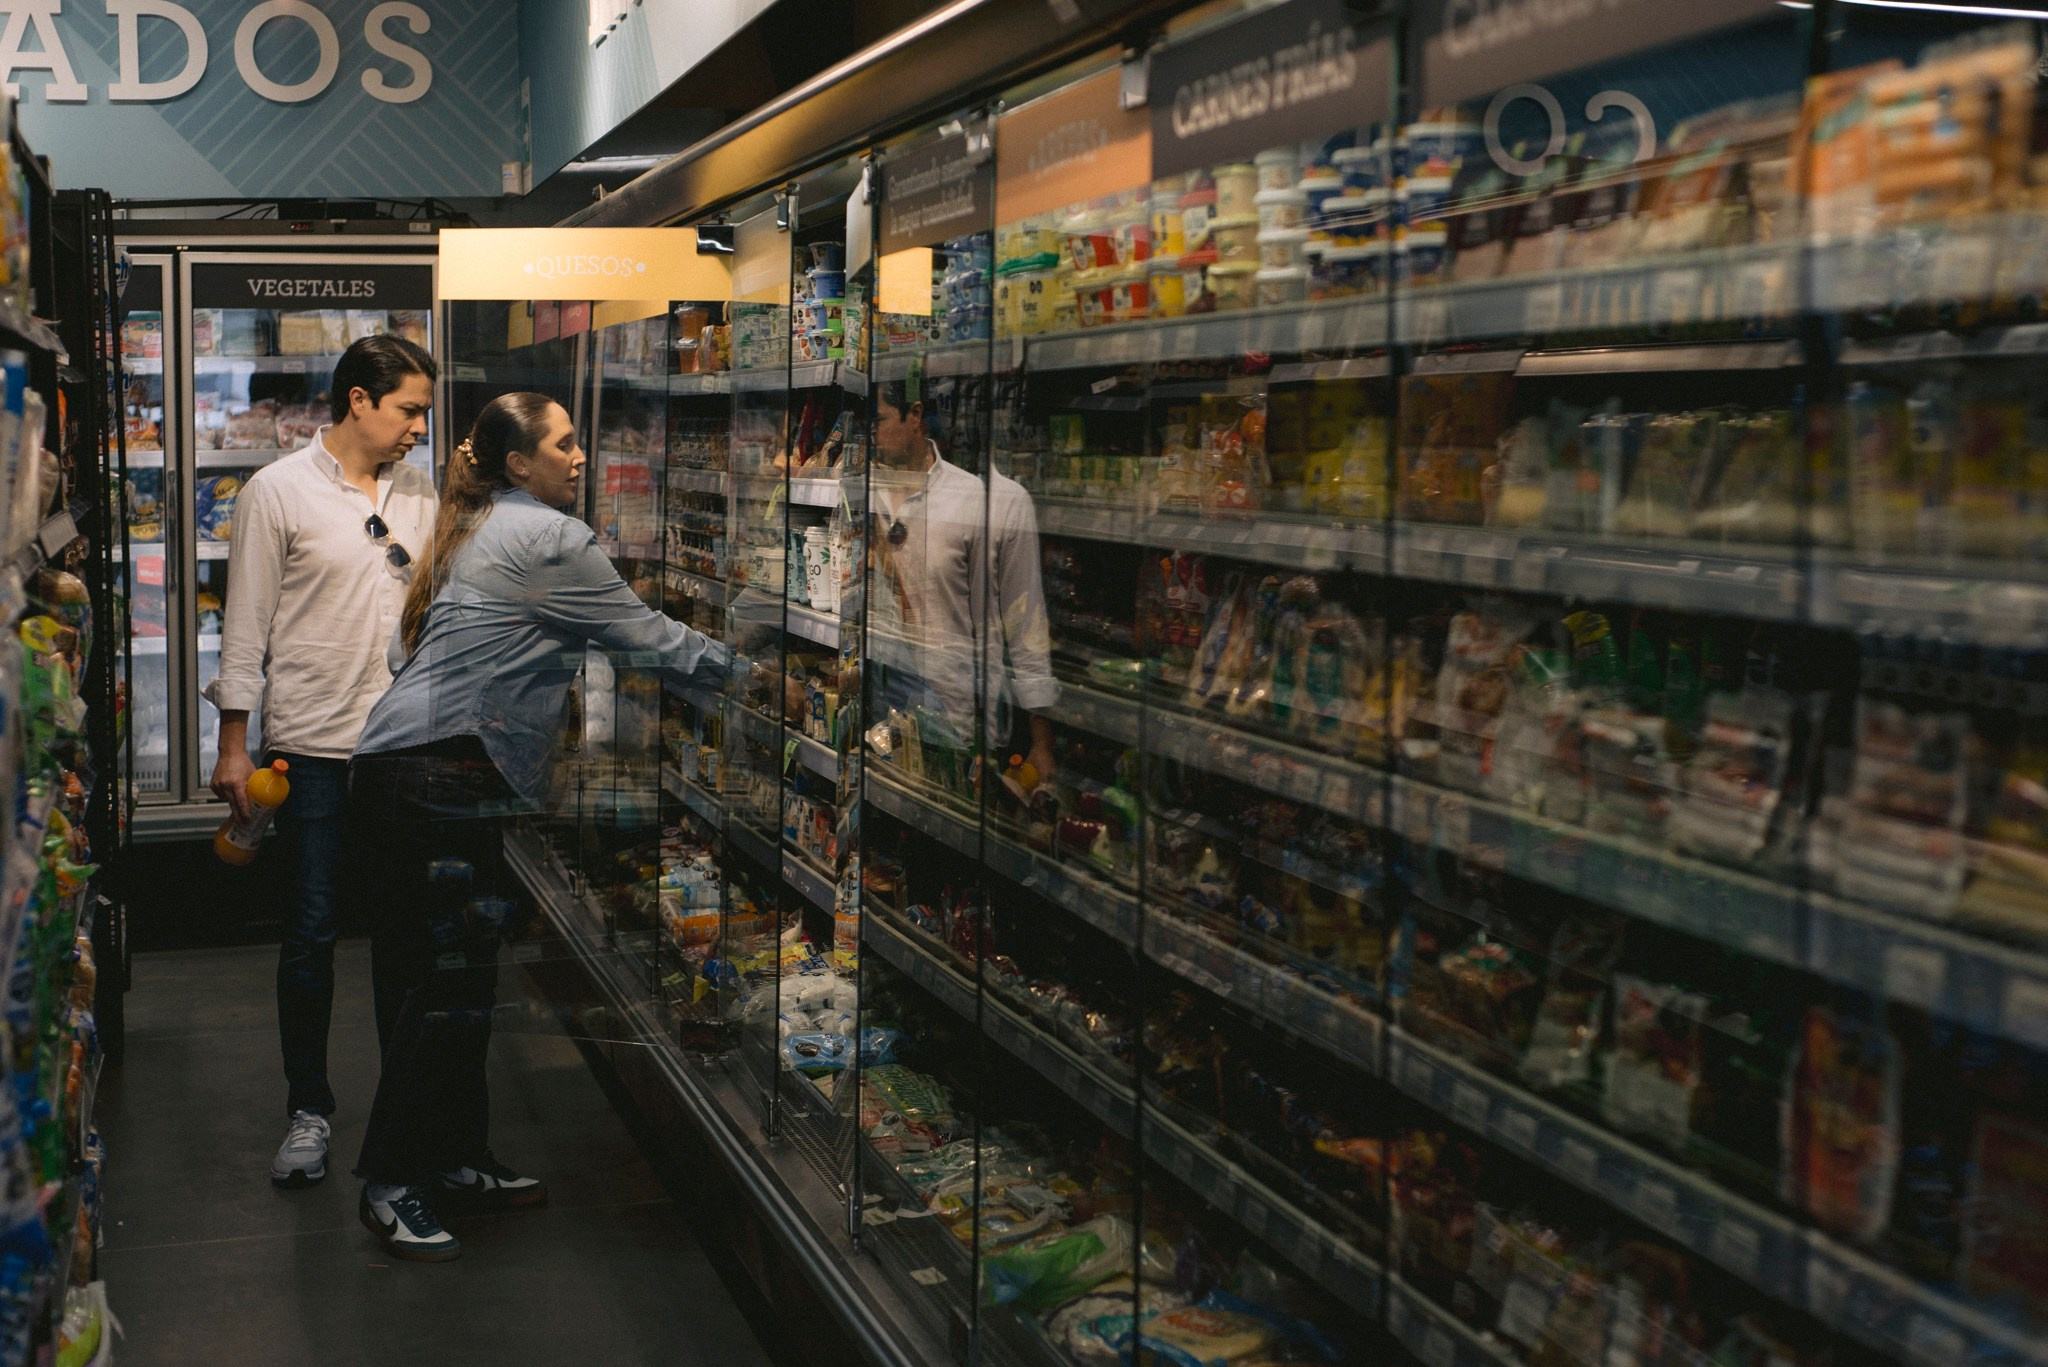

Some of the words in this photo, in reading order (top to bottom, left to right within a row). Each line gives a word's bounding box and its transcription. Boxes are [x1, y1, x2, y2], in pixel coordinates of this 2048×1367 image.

[0, 0, 433, 103] ADOS
[1173, 58, 1270, 138] CARNES
[247, 279, 376, 297] VEGETALES
[536, 255, 633, 279] QUESOS
